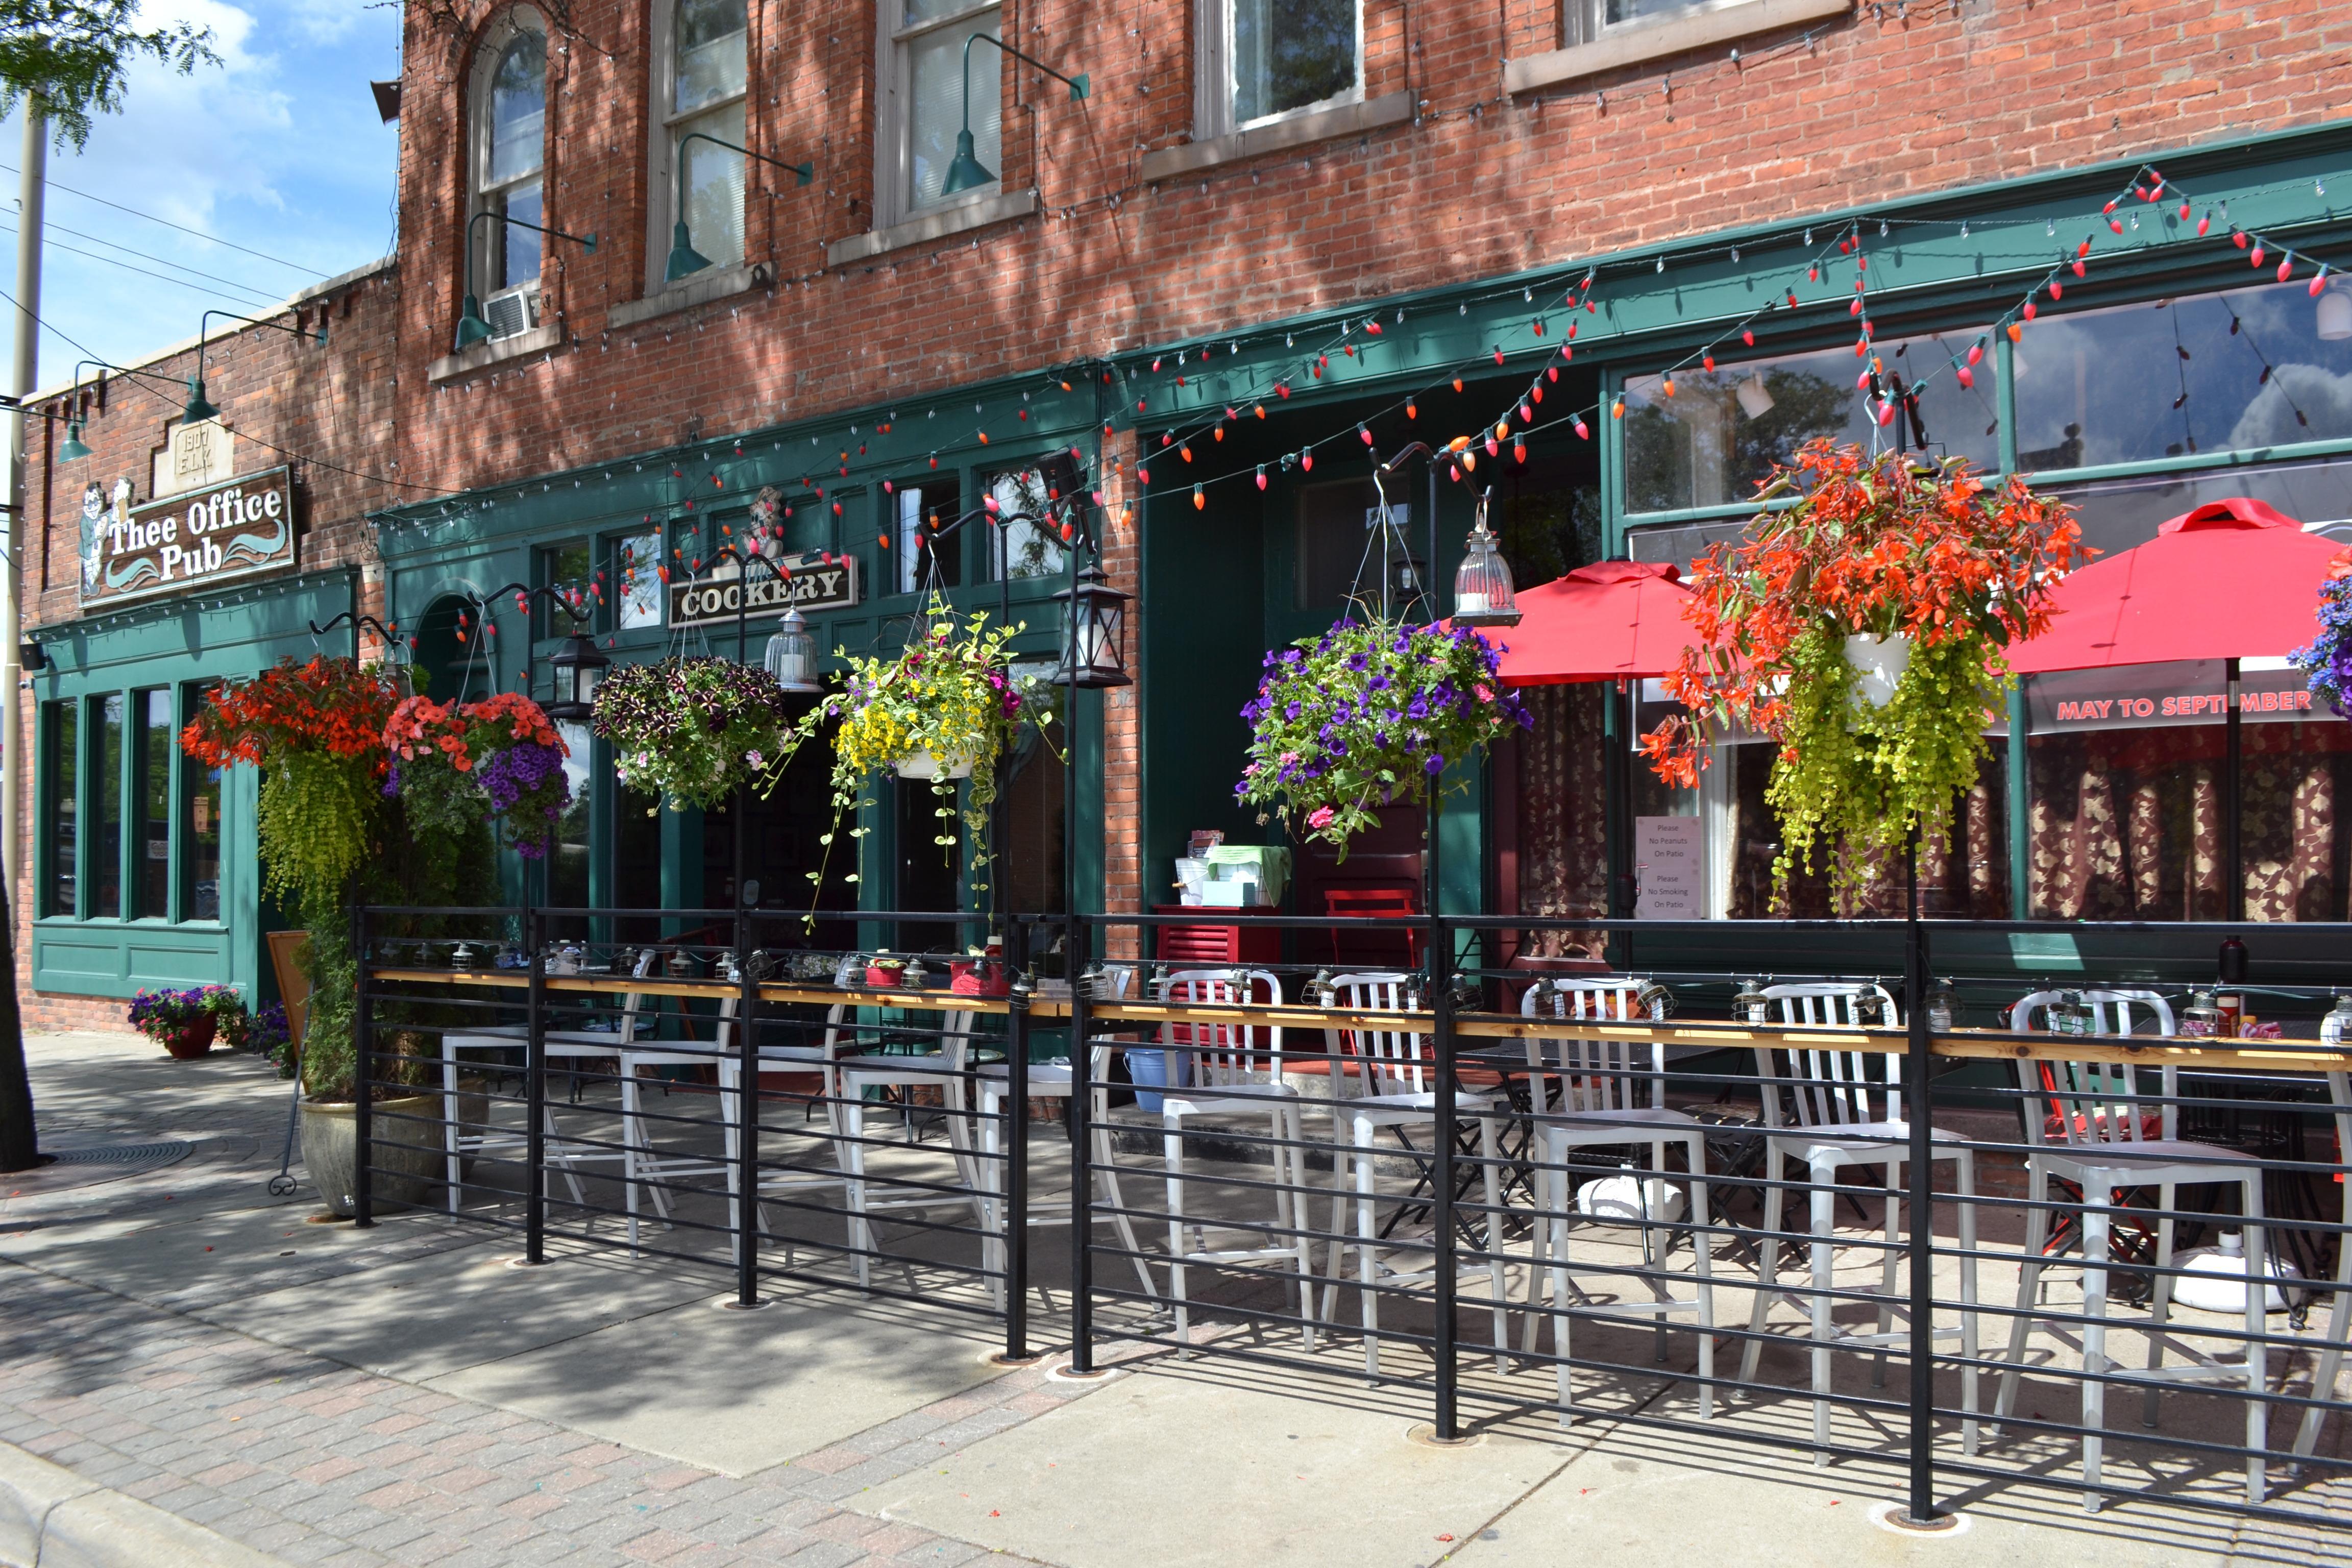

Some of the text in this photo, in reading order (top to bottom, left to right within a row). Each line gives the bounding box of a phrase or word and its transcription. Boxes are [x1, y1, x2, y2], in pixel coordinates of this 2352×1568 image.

[183, 428, 208, 452] 1907
[109, 488, 281, 555] Thee Office
[160, 537, 223, 581] Pub
[681, 570, 842, 616] COOKERY
[2057, 700, 2112, 720] MAY
[2118, 698, 2154, 717] TO
[1659, 888, 1688, 896] Smoking
